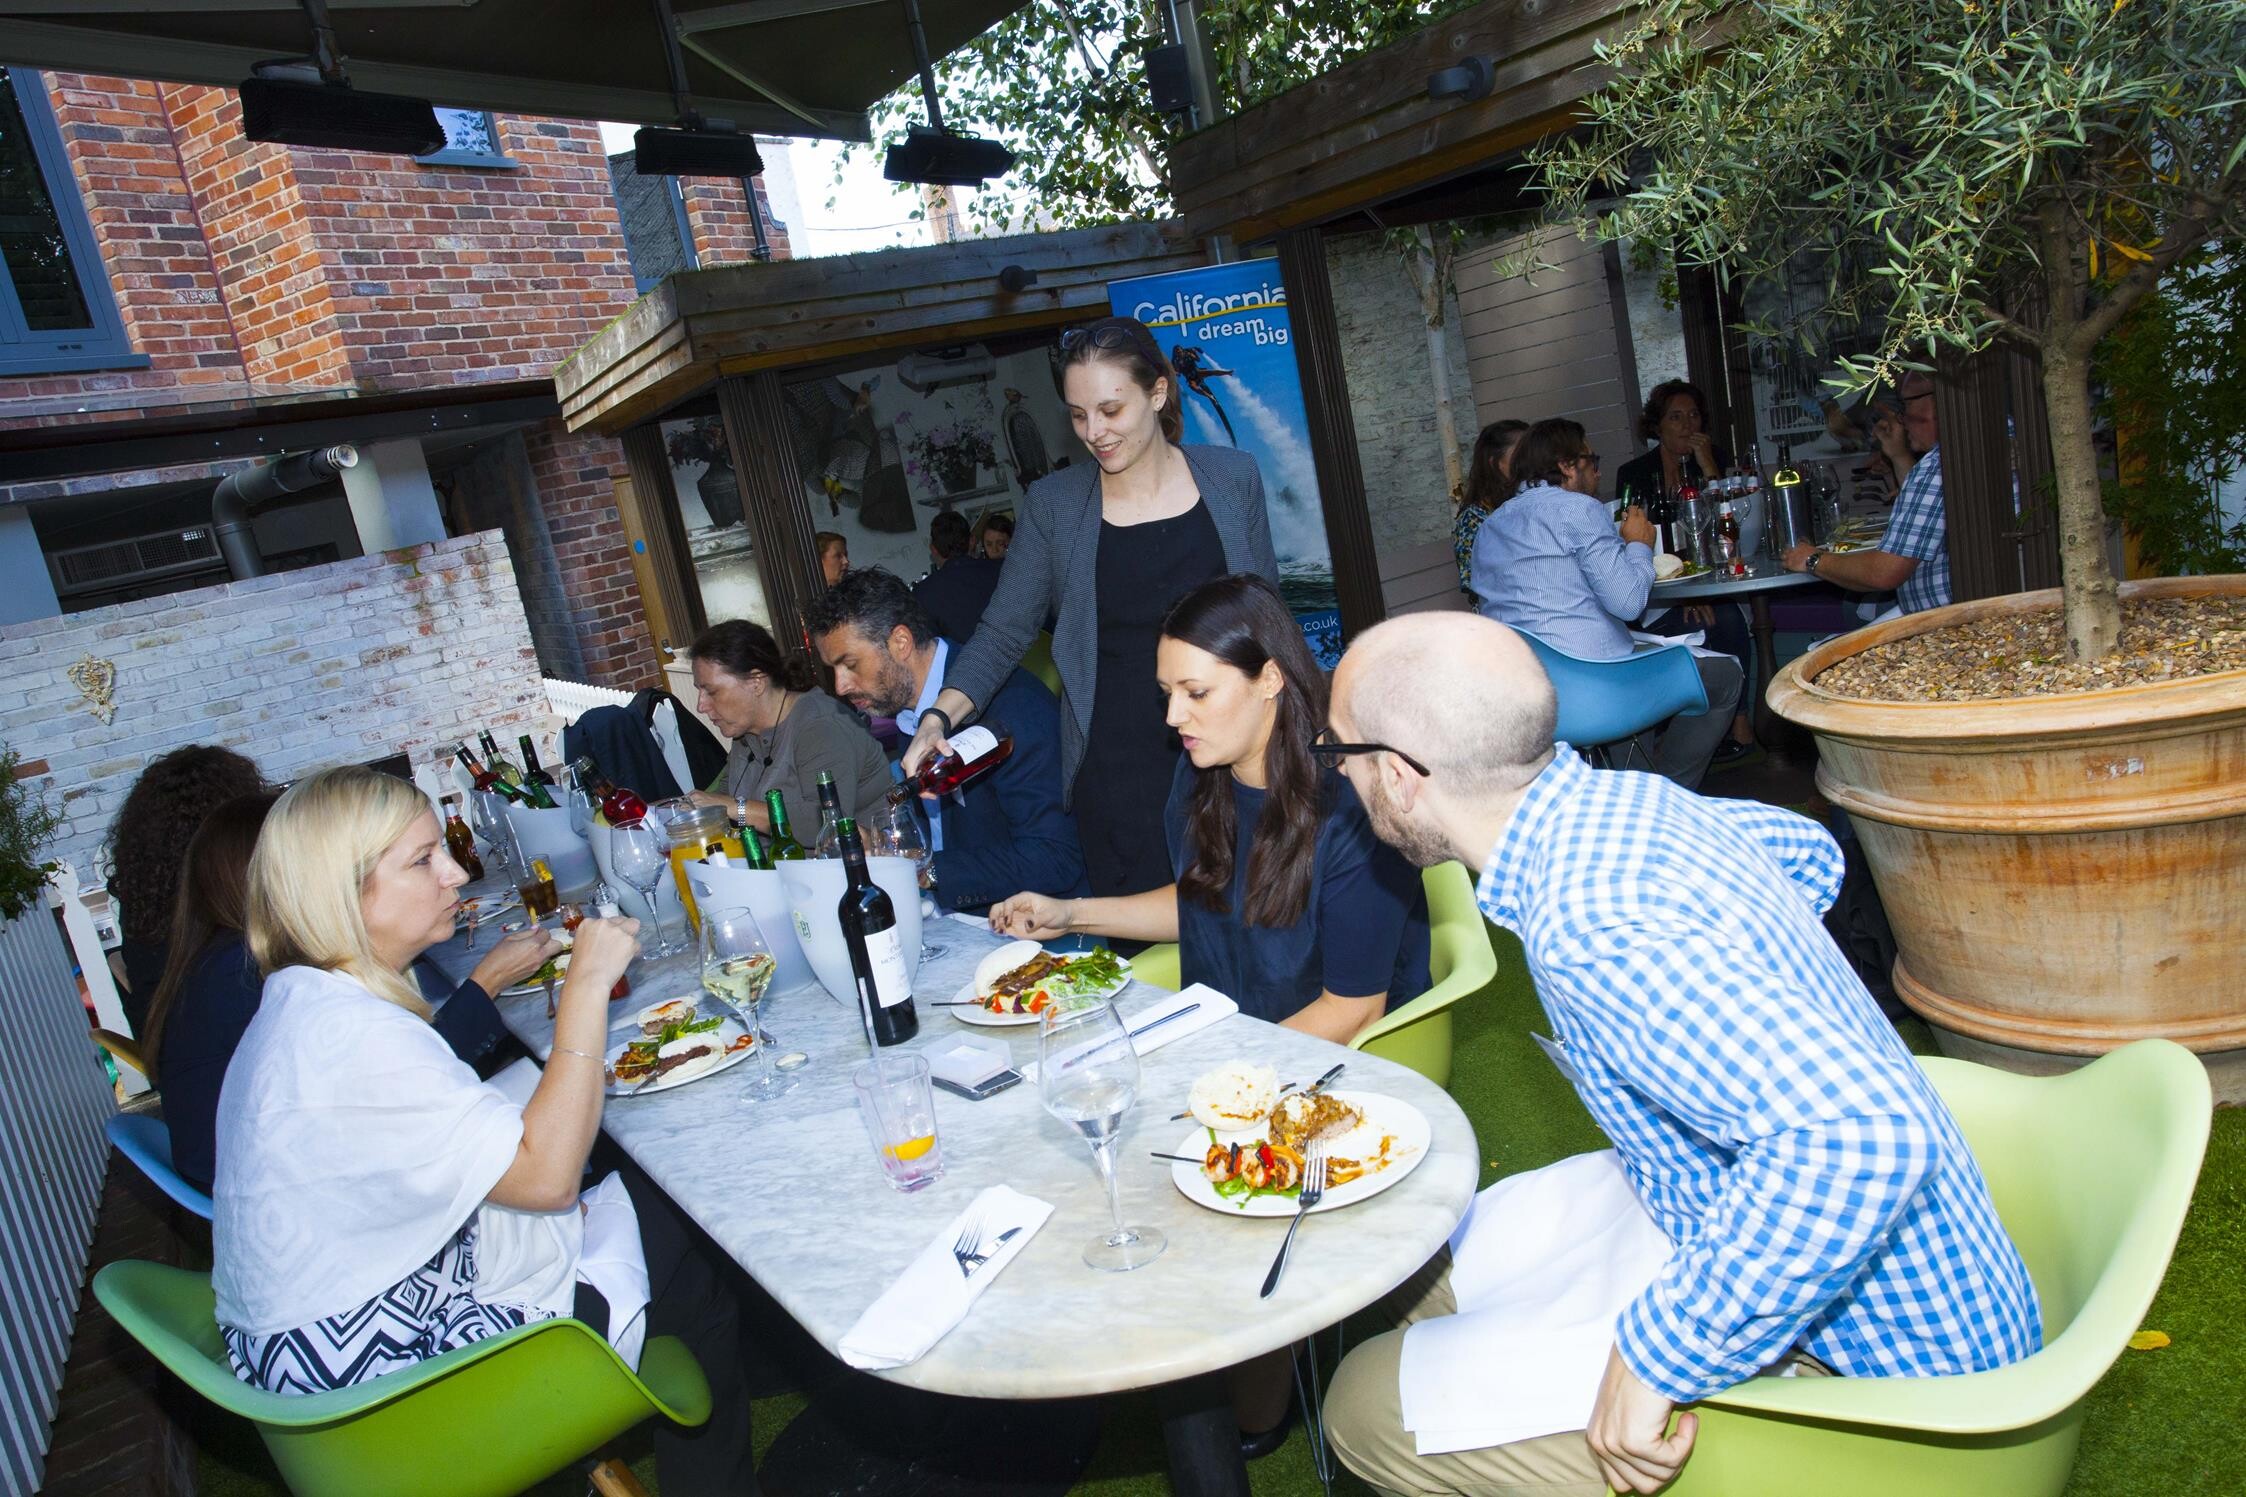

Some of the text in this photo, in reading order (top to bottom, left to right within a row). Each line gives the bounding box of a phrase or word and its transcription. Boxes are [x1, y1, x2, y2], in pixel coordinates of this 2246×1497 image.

[1133, 282, 1287, 337] California
[1199, 318, 1265, 340] dream
[1254, 326, 1289, 346] big
[1303, 615, 1339, 632] .co.uk
